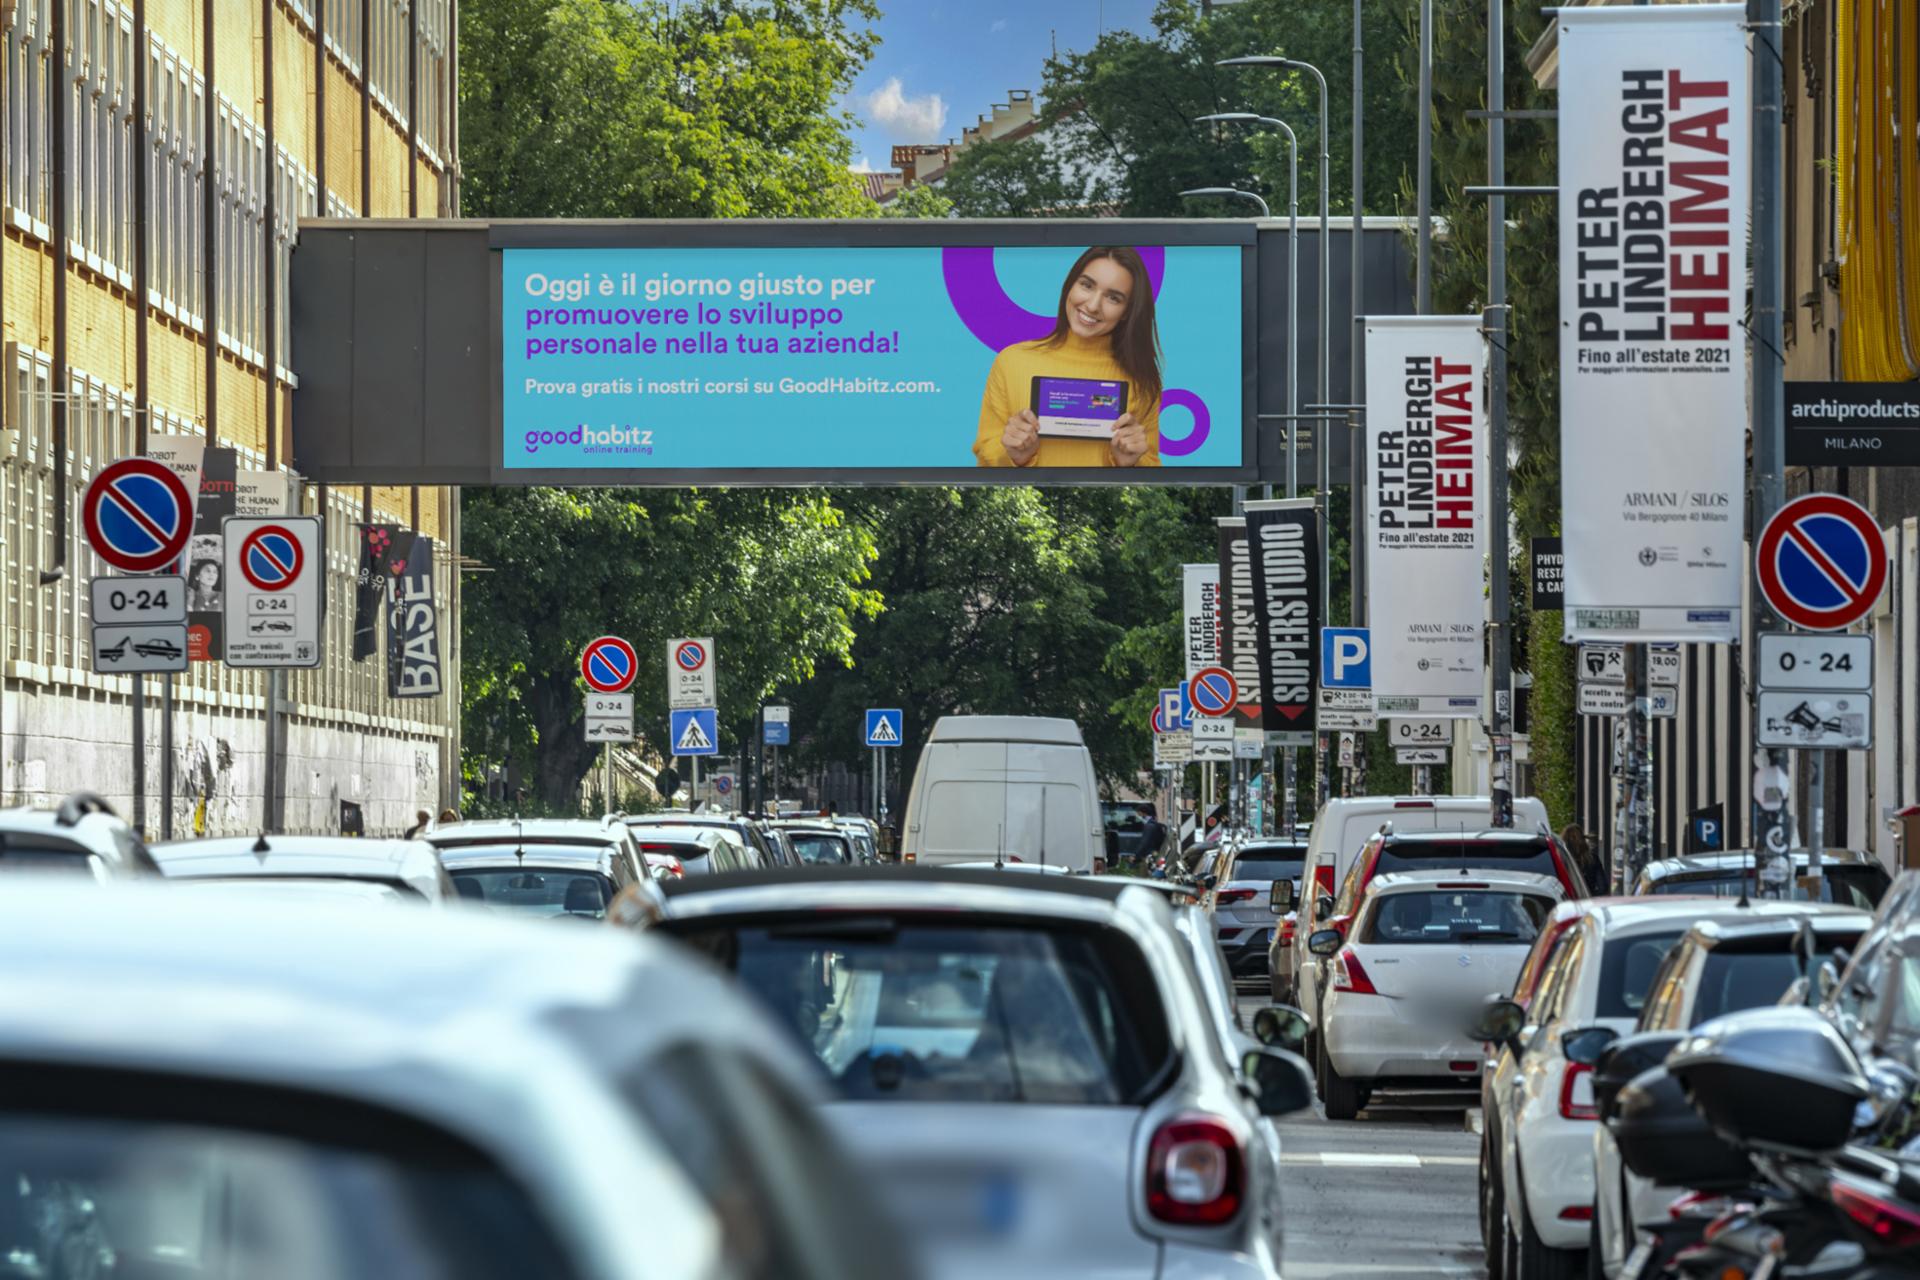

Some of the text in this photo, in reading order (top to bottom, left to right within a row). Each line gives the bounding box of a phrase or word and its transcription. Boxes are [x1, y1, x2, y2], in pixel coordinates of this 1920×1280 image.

[1621, 69, 1665, 341] LINDBERGH
[1668, 69, 1730, 341] HEIMAT
[1577, 186, 1619, 342] PETER
[525, 273, 875, 302] Oggi è il giorno giusto per
[526, 302, 843, 331] promuovere lo sviluppo
[526, 331, 899, 359] personale nella tua azienda!
[1578, 348, 1730, 364] Fino all'estate 2021
[525, 377, 941, 398] Prova gratis i nostri corsi su GoodHabitz.com.
[1792, 399, 1920, 422] archiproducts
[525, 424, 653, 453] goodhabitz
[1405, 356, 1434, 528] LINDBERGH
[1434, 356, 1473, 528] HEIMAT
[1825, 438, 1882, 449] MILANO
[584, 446, 653, 455] online training
[1378, 430, 1405, 528] PETER
[249, 496, 279, 505] HUMAN
[1625, 493, 1677, 507] ARMANI
[1691, 492, 1729, 507] SILOS
[1623, 512, 1636, 521] Via
[1638, 512, 1687, 523] Bergognone
[1702, 512, 1729, 522] Milano
[1379, 533, 1474, 543] Fino all'estate 2021
[1537, 582, 1544, 593] &
[110, 590, 168, 611] 0-24
[256, 599, 287, 610] 0-24
[1202, 582, 1216, 662] LINDBERGH
[1260, 523, 1311, 703] SUPERSTUDIO
[398, 573, 441, 696] BASE
[1190, 616, 1202, 662] PETER
[1408, 624, 1441, 633] ARMANI
[1450, 624, 1474, 633] SILOS
[1333, 636, 1367, 680] P
[1202, 724, 1225, 732] 0-24
[1400, 723, 1442, 738] 0-24
[1702, 821, 1716, 842] P
